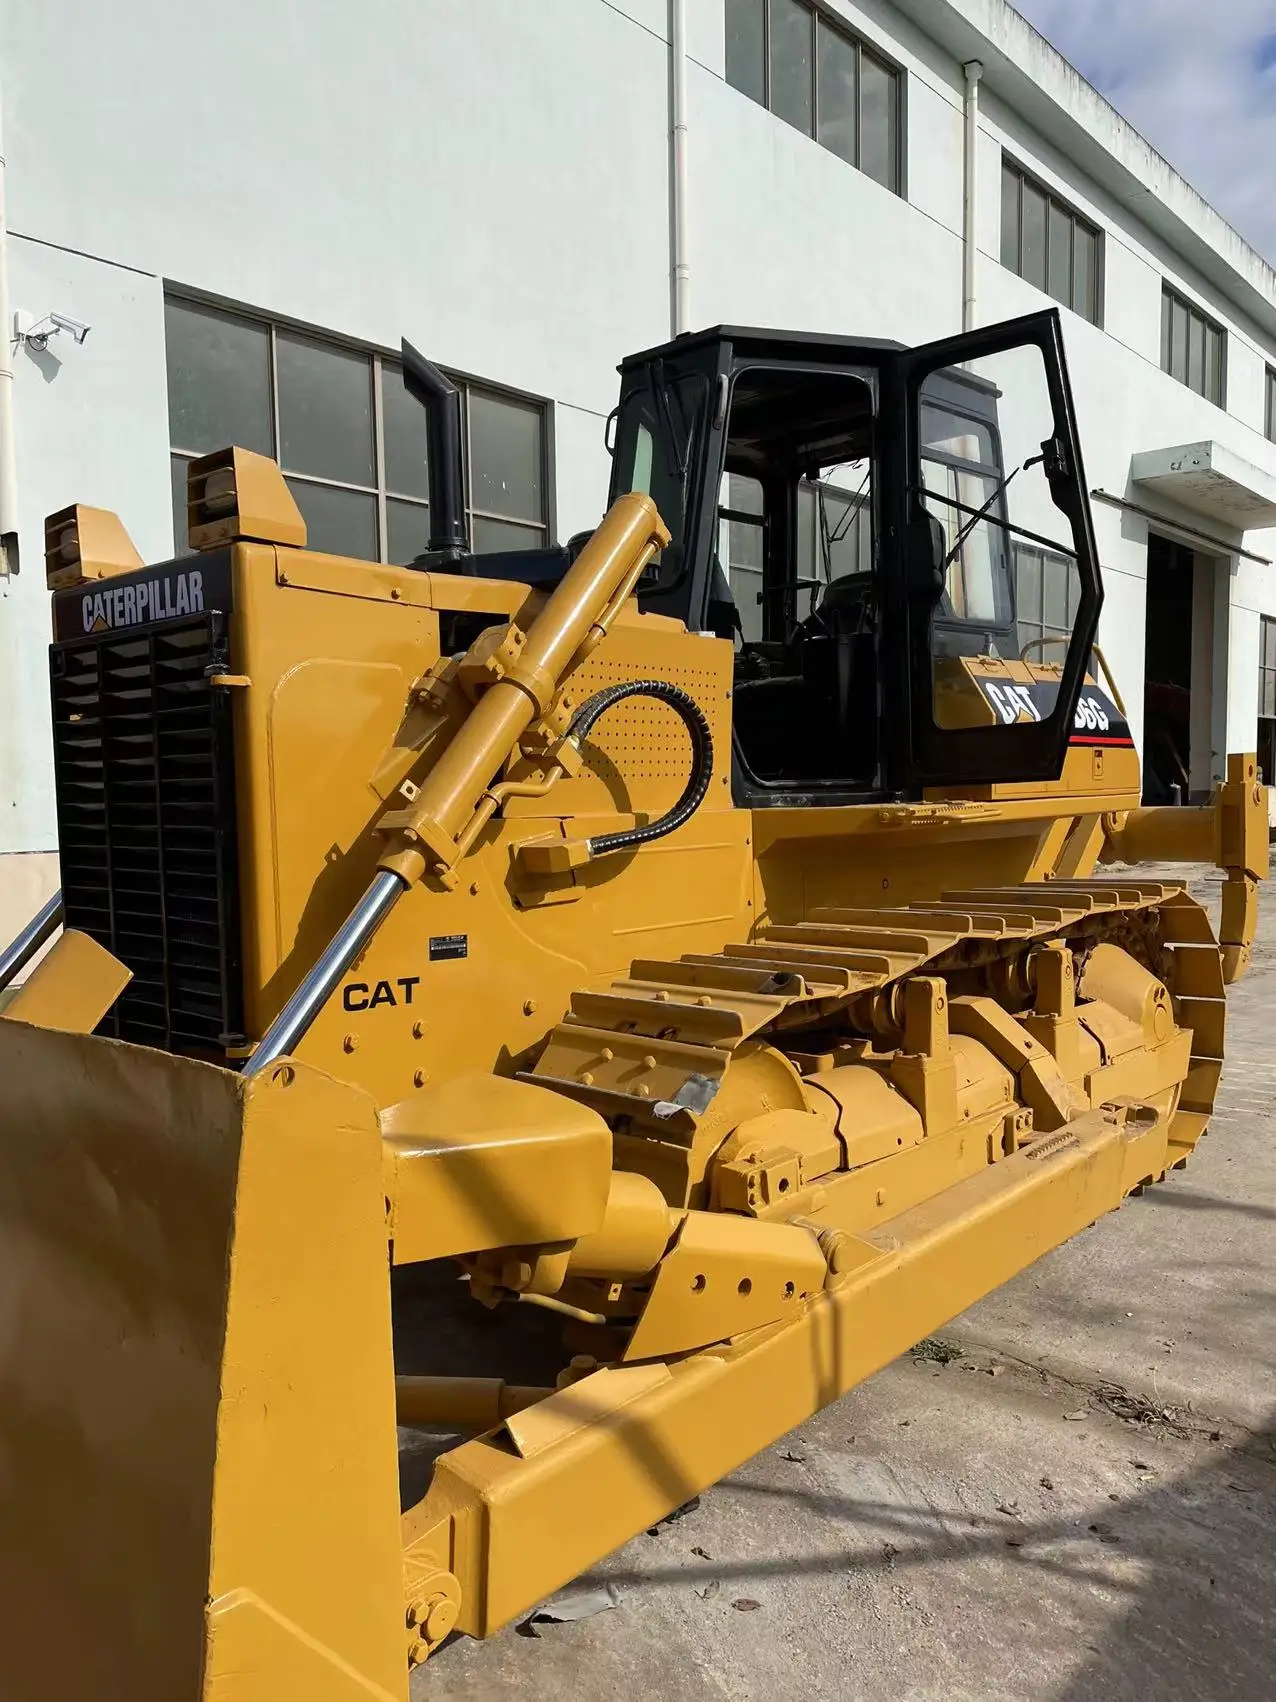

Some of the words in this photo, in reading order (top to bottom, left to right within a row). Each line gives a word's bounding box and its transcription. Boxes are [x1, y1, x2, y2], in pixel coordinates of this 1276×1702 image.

[82, 570, 204, 633] CATERPILLAR
[985, 682, 1041, 725] CAT
[343, 976, 420, 1012] CAT
